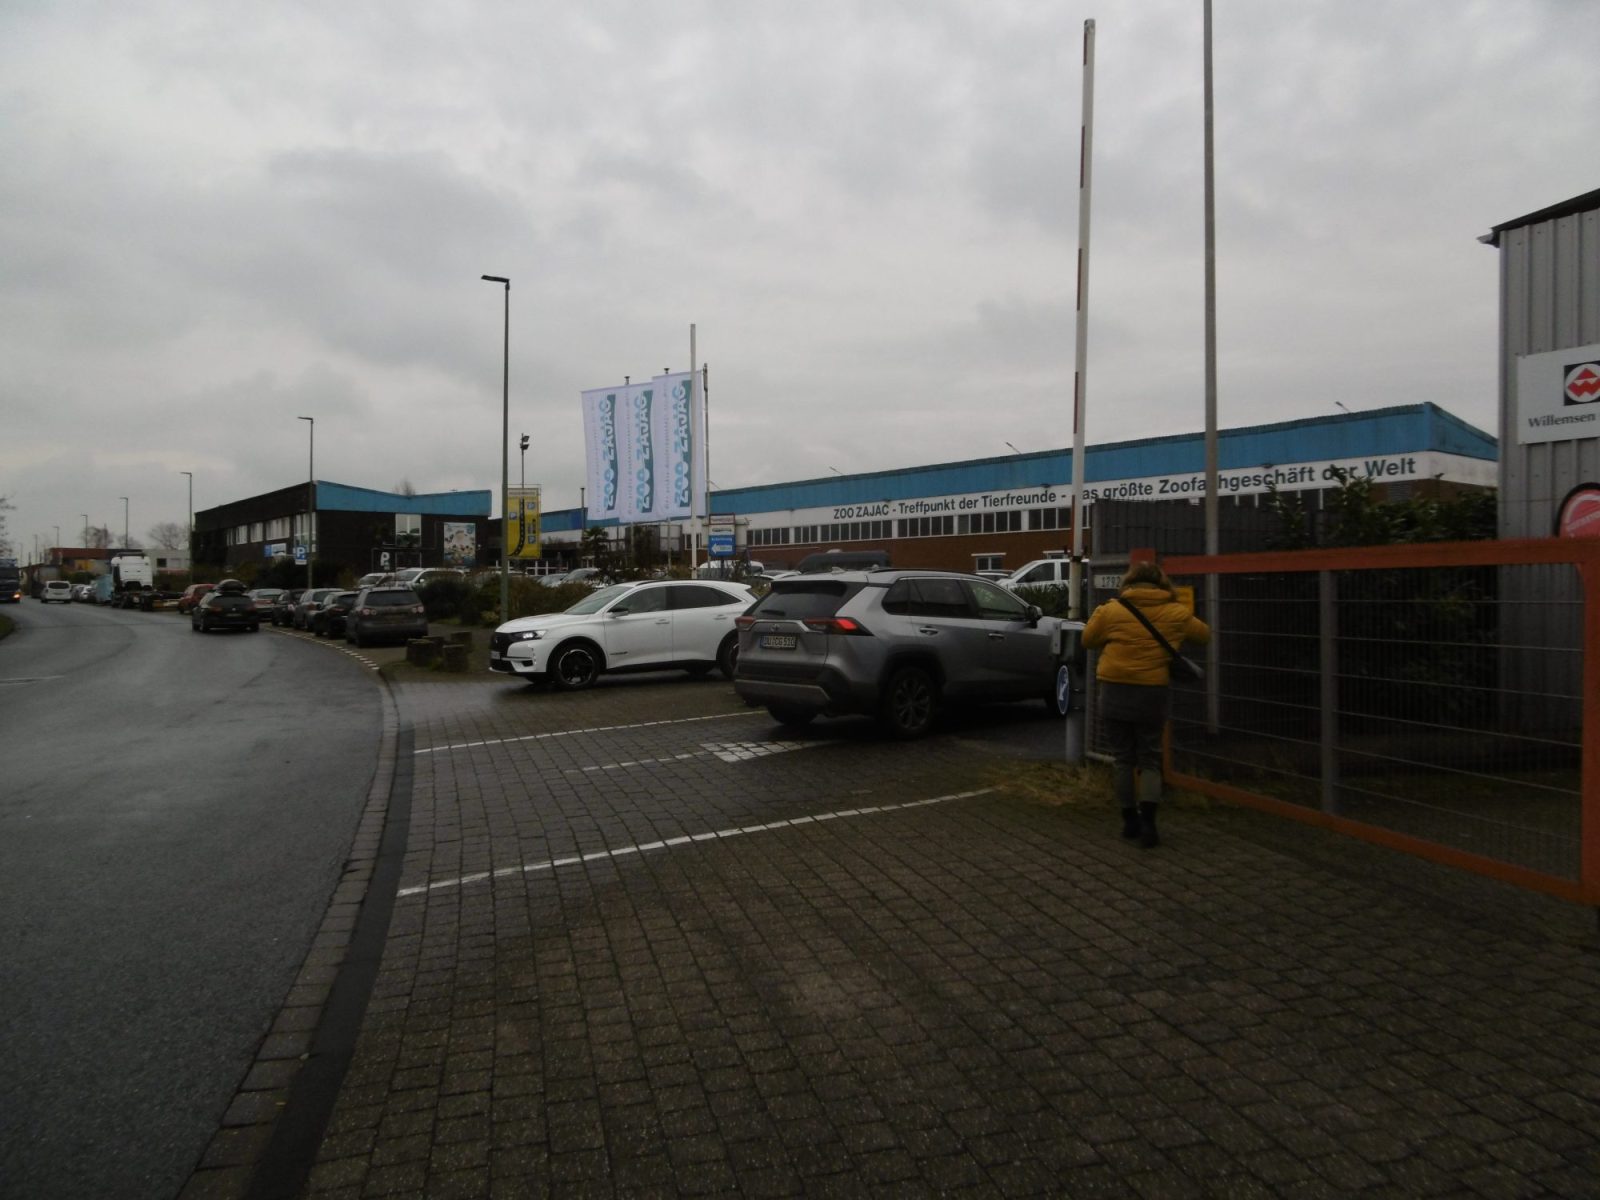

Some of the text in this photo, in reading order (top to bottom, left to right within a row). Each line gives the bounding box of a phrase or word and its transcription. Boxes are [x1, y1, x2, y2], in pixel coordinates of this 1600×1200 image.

[599, 400, 615, 508] ZOO ZAJAC
[634, 395, 650, 511] ZOO ZAJAC
[672, 385, 689, 504] ZOO ZAJAC
[1528, 413, 1596, 428] Willemsen
[833, 507, 854, 519] ZOO
[856, 504, 889, 517] ZAJAC
[899, 499, 955, 514] Treffpunkt
[959, 497, 979, 509] der
[981, 490, 1056, 507] Tierfreunde
[1103, 482, 1153, 500] größte
[1159, 466, 1315, 494] Zoofahgeschäft
[1365, 457, 1416, 477] Welt
